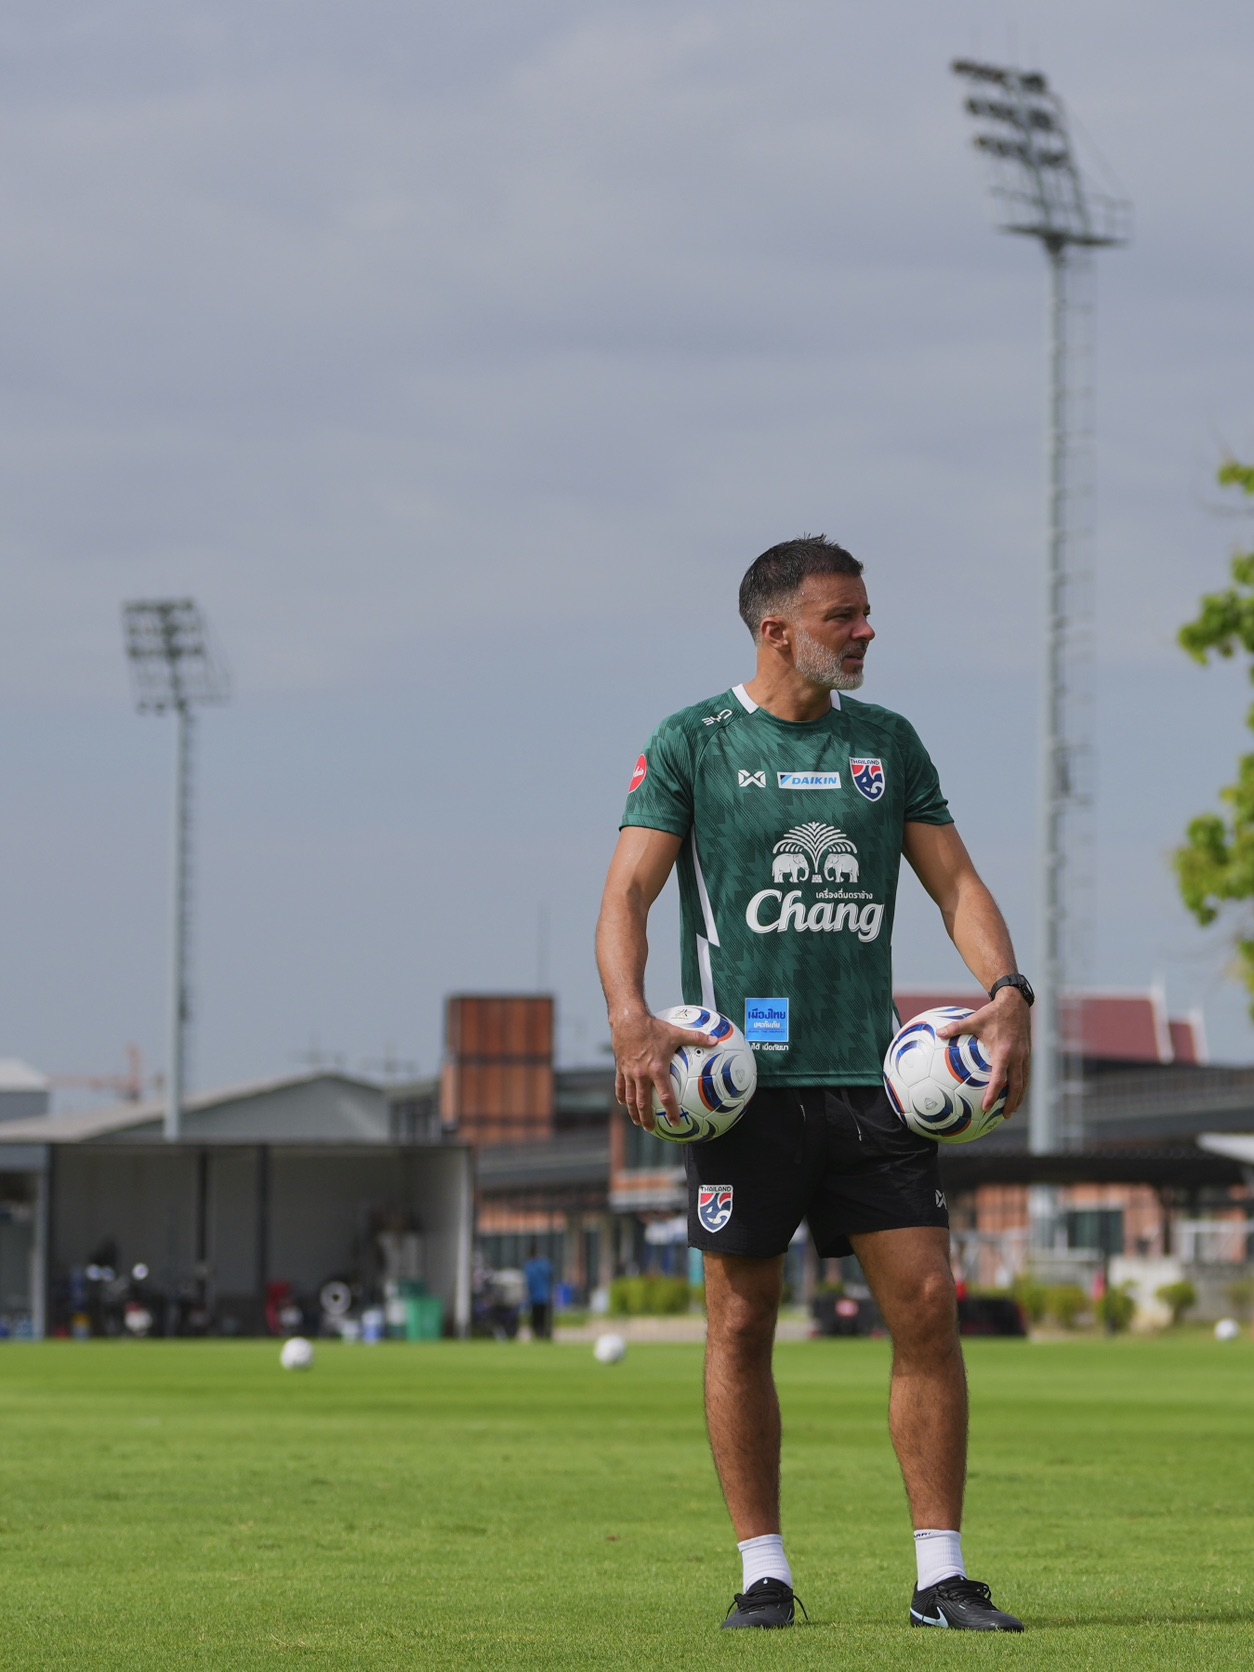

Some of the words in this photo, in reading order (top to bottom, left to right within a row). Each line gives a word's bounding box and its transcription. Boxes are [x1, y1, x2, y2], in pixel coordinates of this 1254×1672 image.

[791, 776, 837, 785] DAIKIN
[816, 888, 873, 899] เครื่องดื่มตราช้าง
[745, 888, 885, 943] Chang
[748, 1008, 786, 1019] เมืองไทย
